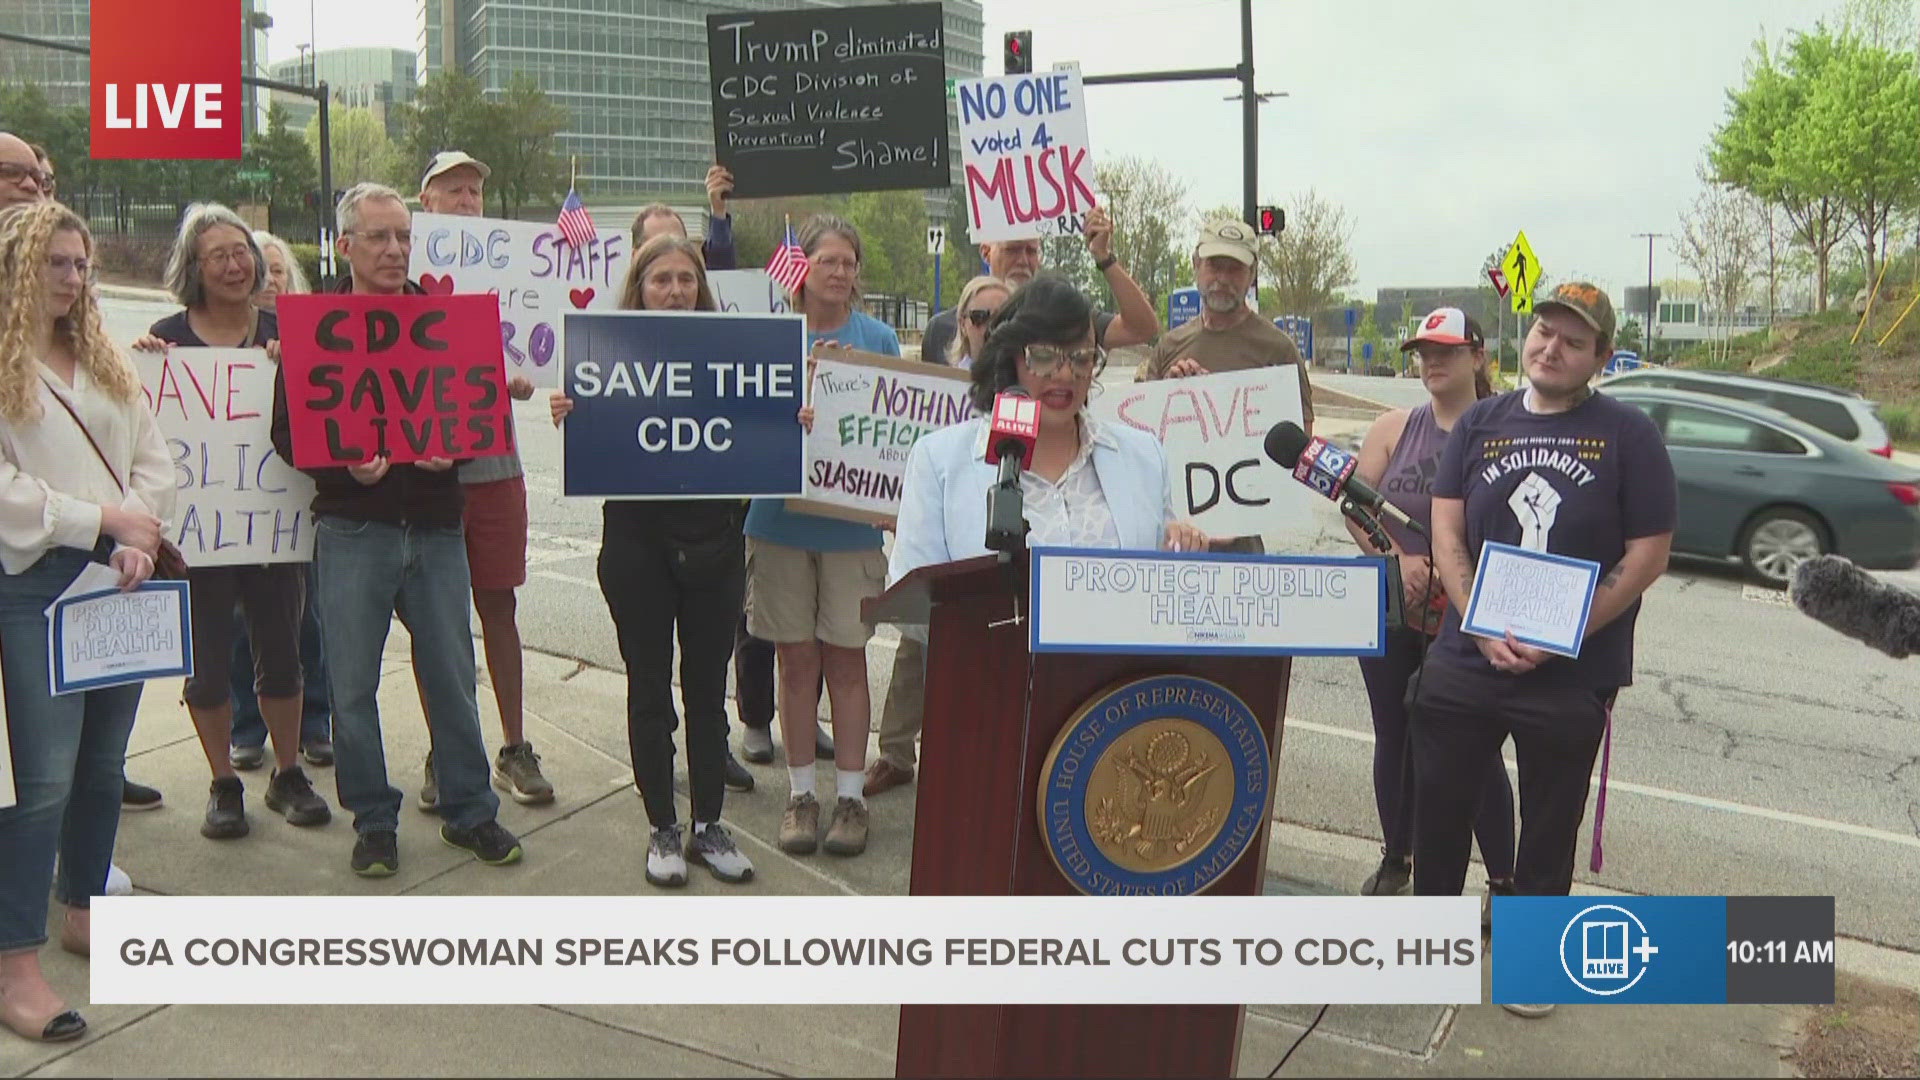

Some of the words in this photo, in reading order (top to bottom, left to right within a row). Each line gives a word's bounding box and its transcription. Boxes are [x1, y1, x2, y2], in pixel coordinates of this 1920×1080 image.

[834, 27, 940, 58] eliminated
[720, 75, 778, 99] CDC
[796, 72, 879, 93] Division
[890, 67, 918, 84] of
[960, 81, 1006, 125] NO
[1014, 75, 1071, 116] ONE
[728, 101, 796, 126] Sexual
[807, 100, 883, 121] Violence
[728, 128, 826, 147] Prevention!
[832, 137, 938, 169] Shame!
[971, 128, 1022, 155] voted
[1031, 122, 1053, 149] 4
[966, 145, 1096, 230] MUSK
[426, 228, 511, 269] CDC
[530, 232, 622, 287] STAFF
[315, 309, 448, 354] CDC
[500, 321, 555, 366] RO
[305, 364, 497, 415] SAVES
[573, 361, 693, 398] SAVE
[707, 363, 794, 398] THE
[816, 371, 871, 396] There's
[996, 419, 1034, 433] ALIVE
[1117, 384, 1268, 446] SAVE
[325, 414, 512, 461] LIVES!
[636, 416, 732, 452] CDC
[166, 438, 287, 493] BLIC
[878, 449, 908, 462] ABOU
[1304, 438, 1325, 462] FOX
[1319, 447, 1345, 478] 5
[1482, 462, 1501, 485] IN
[1500, 448, 1595, 487] SOLIDARITY
[1185, 458, 1270, 515] DC
[178, 504, 301, 553] ALTH
[1065, 560, 1221, 595] PROTECT
[1233, 566, 1347, 598] PUBLIC
[1494, 557, 1578, 589] PROTECT
[1502, 575, 1568, 602] PUBLIC
[72, 594, 171, 622] PROTECT
[83, 612, 160, 638] PUBLIC
[1150, 595, 1280, 627] HEALTH
[1484, 591, 1574, 627] HEALTH
[71, 629, 174, 663] HEALTH
[1056, 719, 1106, 790] HOUSE
[1105, 697, 1131, 724] OF
[1134, 686, 1264, 793] REPRESENTATIVES
[1053, 799, 1091, 876] UNITED
[1088, 871, 1156, 895] STATES
[1161, 875, 1188, 895] OF
[1192, 803, 1258, 883] AMERICA
